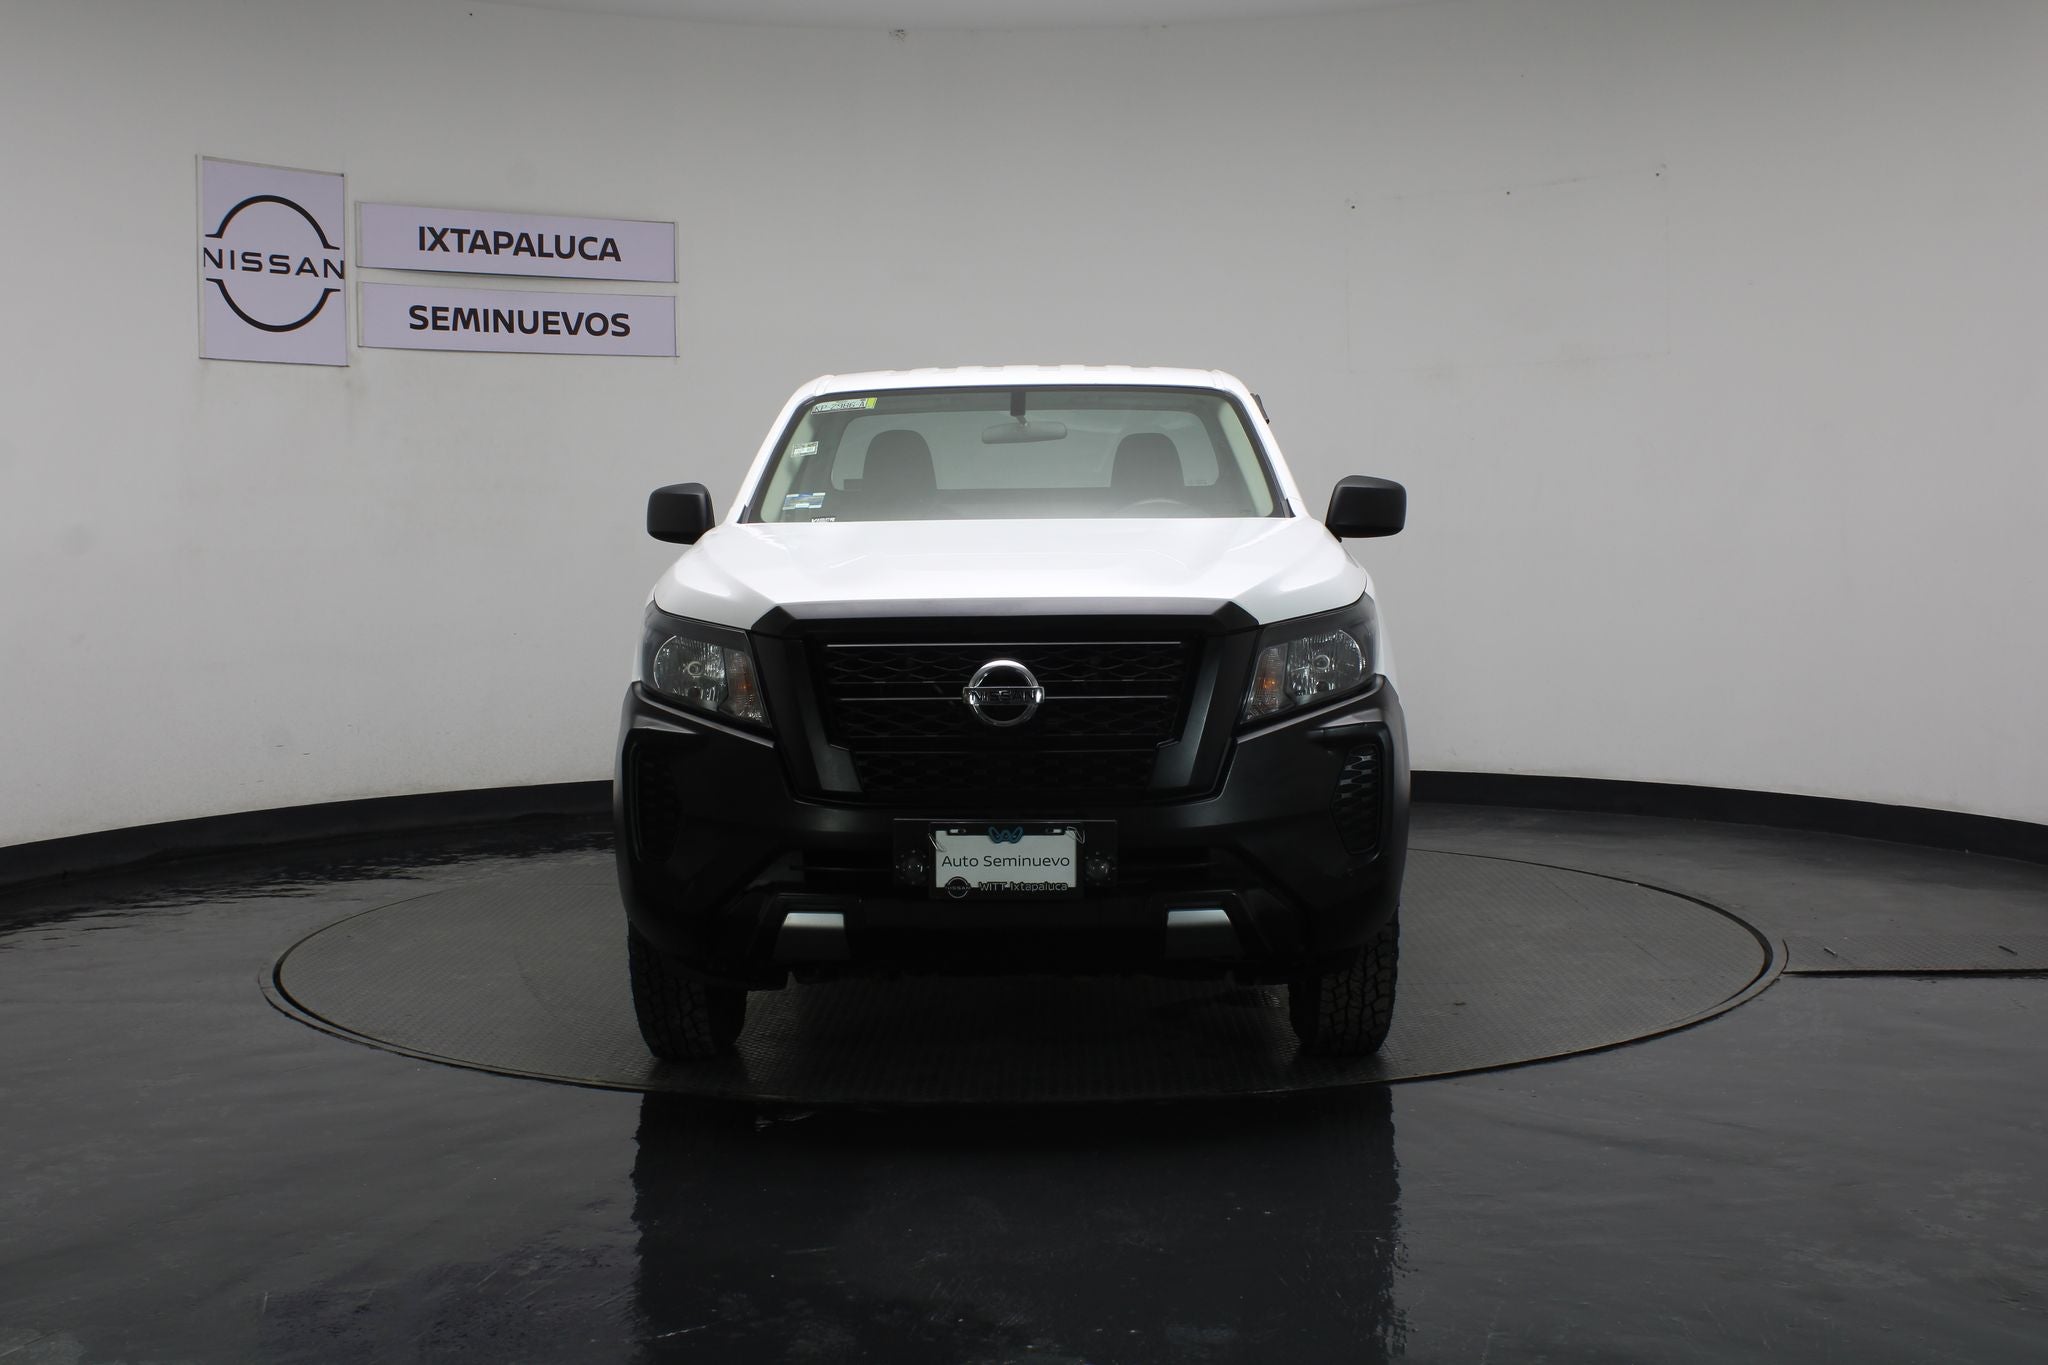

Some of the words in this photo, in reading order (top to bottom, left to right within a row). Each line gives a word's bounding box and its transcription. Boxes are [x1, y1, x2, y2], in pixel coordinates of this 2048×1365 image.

[418, 226, 622, 262] IXTAPALUCA
[203, 246, 345, 280] NISSAN
[409, 304, 631, 337] SEMINUEVOS
[941, 855, 979, 868] Auto
[983, 855, 1070, 868] Seminuevo
[978, 881, 1007, 892] WITT
[1010, 881, 1069, 893] Ixtapaluca
